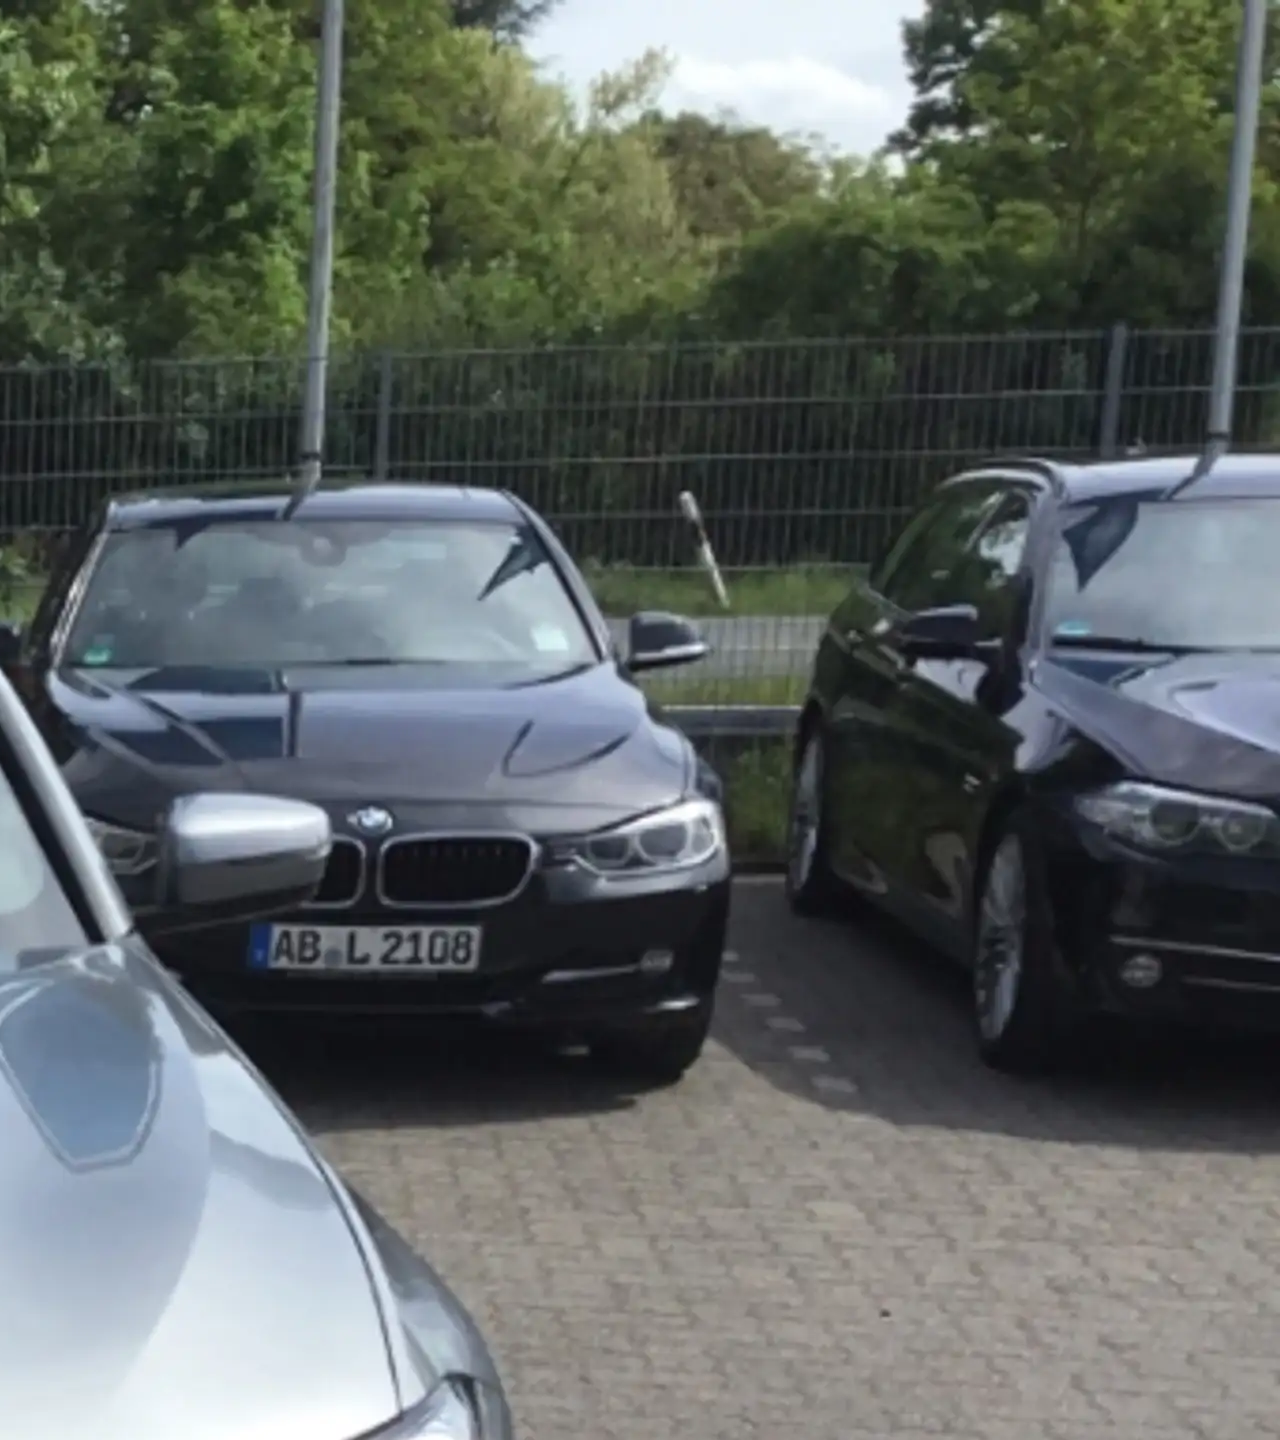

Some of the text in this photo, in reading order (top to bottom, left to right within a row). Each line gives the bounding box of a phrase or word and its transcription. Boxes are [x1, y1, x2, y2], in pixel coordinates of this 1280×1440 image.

[273, 929, 474, 965] AB L 2108
